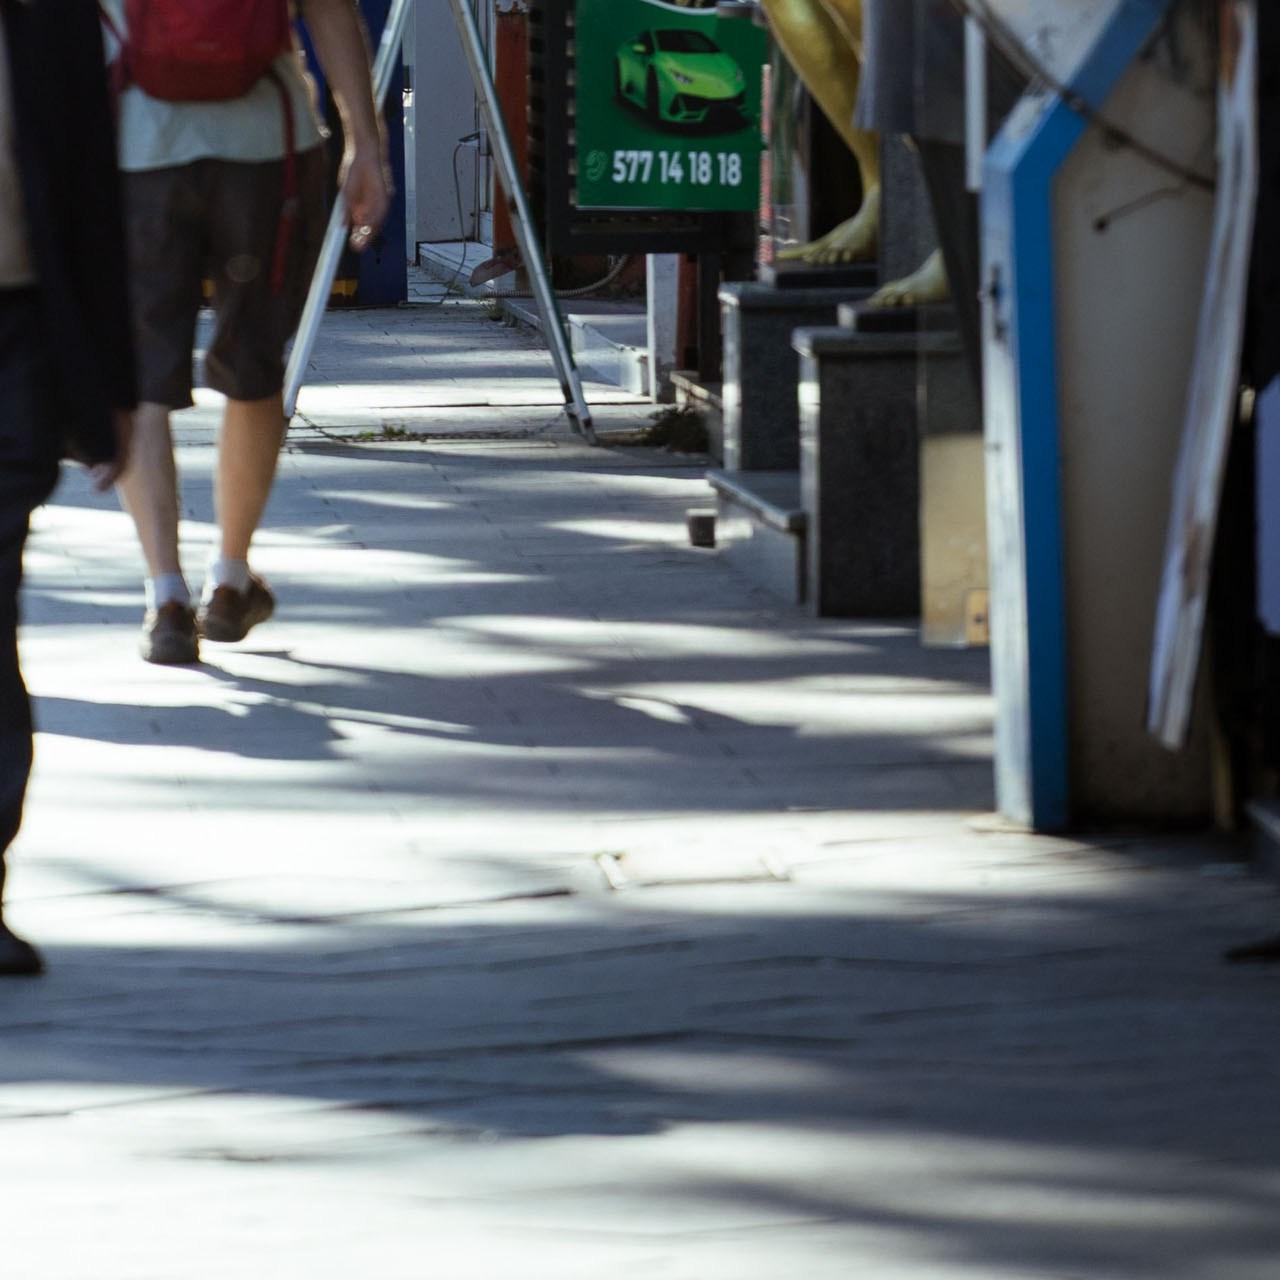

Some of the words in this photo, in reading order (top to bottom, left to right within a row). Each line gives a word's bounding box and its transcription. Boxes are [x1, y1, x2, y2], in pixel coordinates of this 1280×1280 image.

[612, 150, 654, 183] 577
[658, 150, 684, 184] 14
[688, 151, 712, 185] 18
[717, 152, 742, 186] 18
